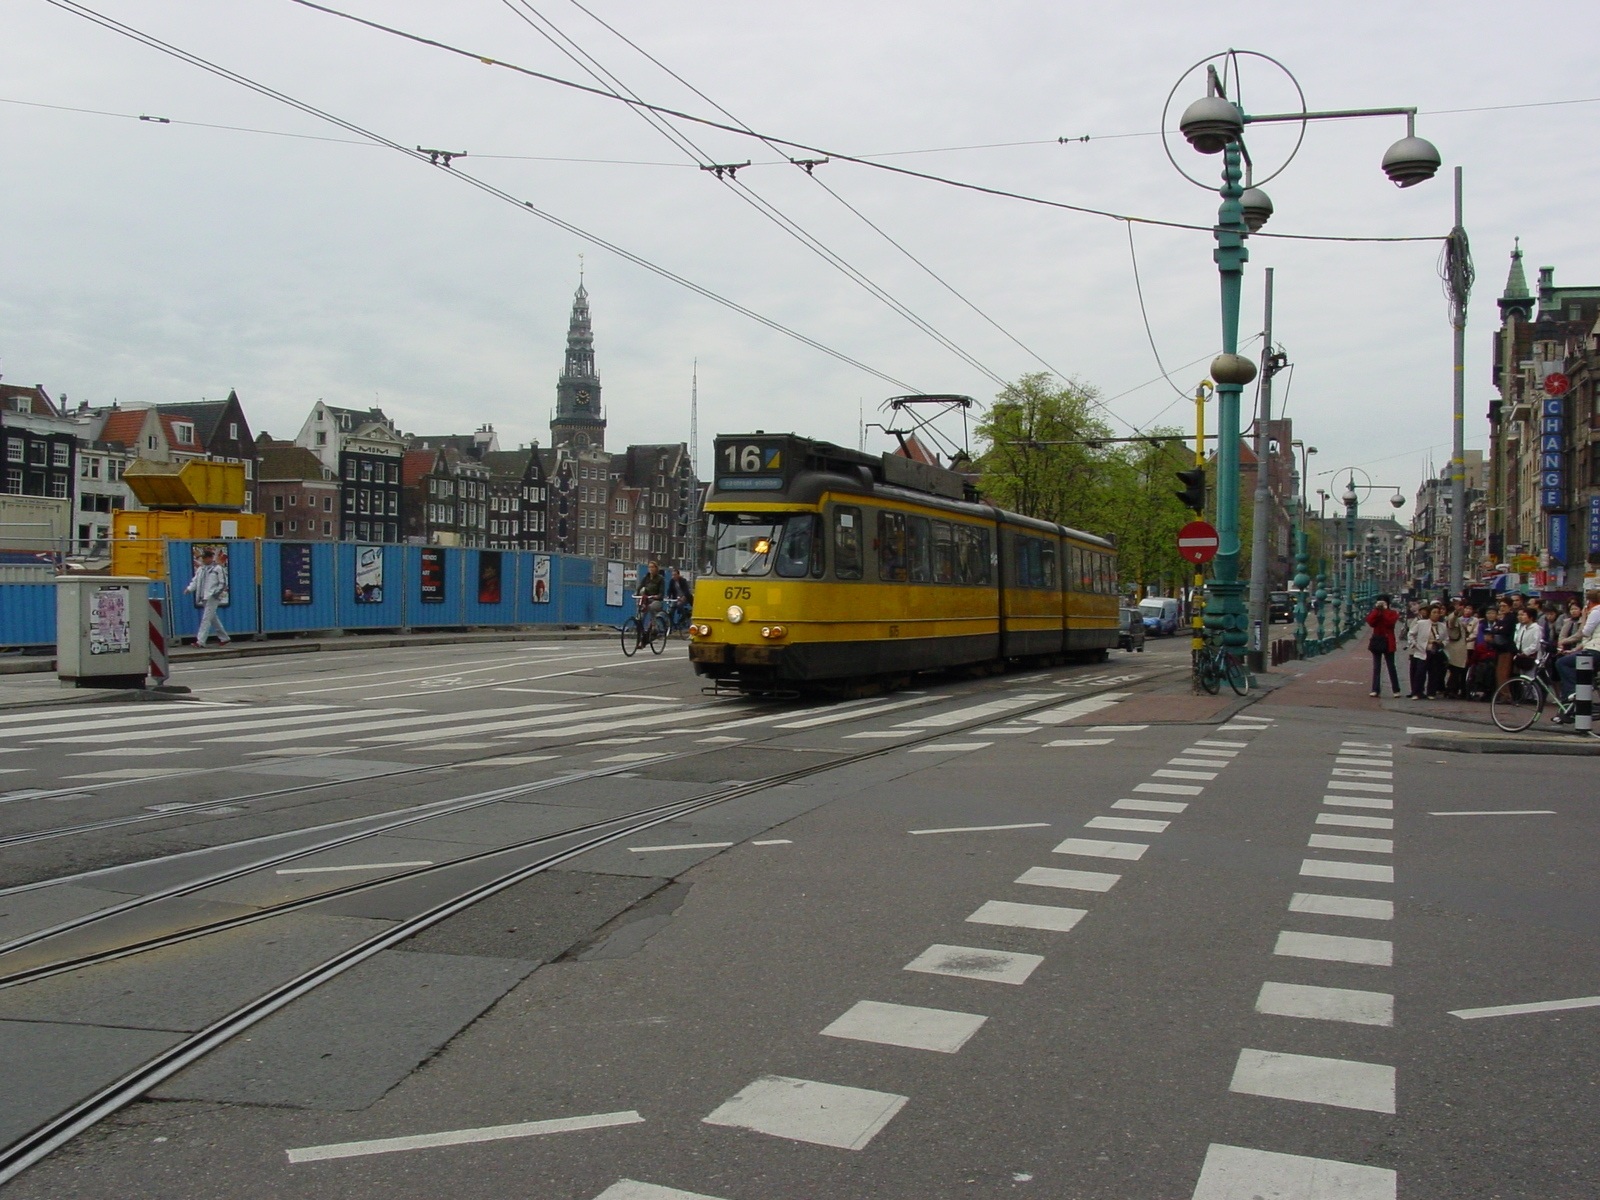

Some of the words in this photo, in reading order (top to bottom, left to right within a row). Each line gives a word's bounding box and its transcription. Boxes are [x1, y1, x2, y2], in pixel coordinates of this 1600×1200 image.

[725, 445, 761, 473] 16
[1546, 401, 1560, 505] CHANGE
[1592, 499, 1600, 549] CHANGE
[724, 586, 751, 600] 675
